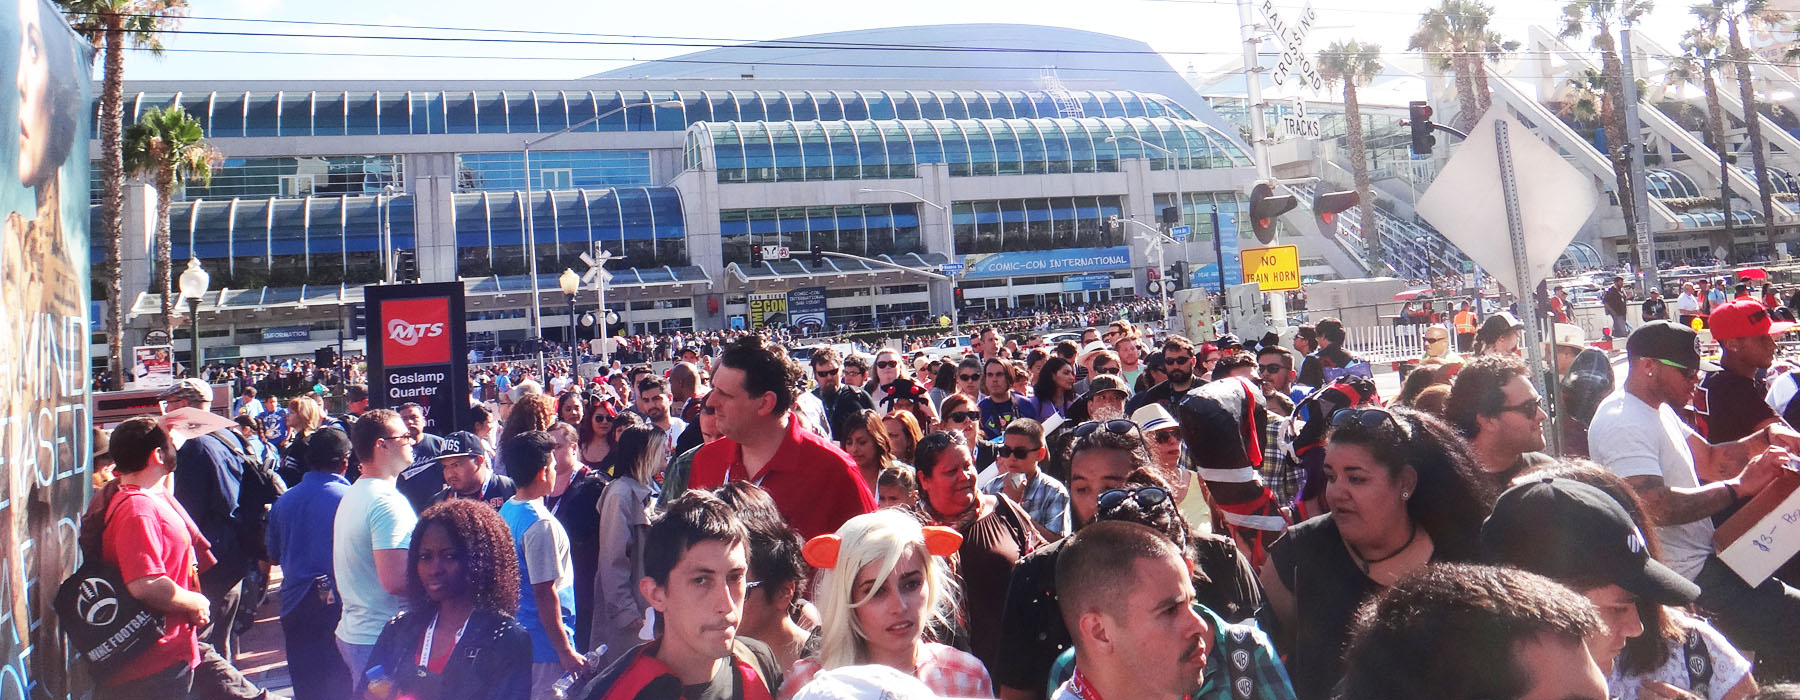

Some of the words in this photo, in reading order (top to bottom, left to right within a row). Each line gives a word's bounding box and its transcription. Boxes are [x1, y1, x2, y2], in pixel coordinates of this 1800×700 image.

[1262, 0, 1287, 42] RAIL
[1297, 52, 1321, 90] ROAD
[1273, 7, 1315, 86] CROSSING
[1297, 102, 1303, 118] 3
[1284, 118, 1319, 137] TRACKS
[988, 260, 1047, 273] COMIC-CON
[1049, 255, 1128, 268] INTERNATIONAL
[1261, 255, 1277, 266] NO
[1246, 273, 1269, 283] TRAIN
[1273, 271, 1296, 282] HORN
[763, 299, 786, 312] CON
[389, 322, 444, 340] MTS
[389, 371, 445, 385] Gaslamp
[389, 386, 438, 399] Quarter
